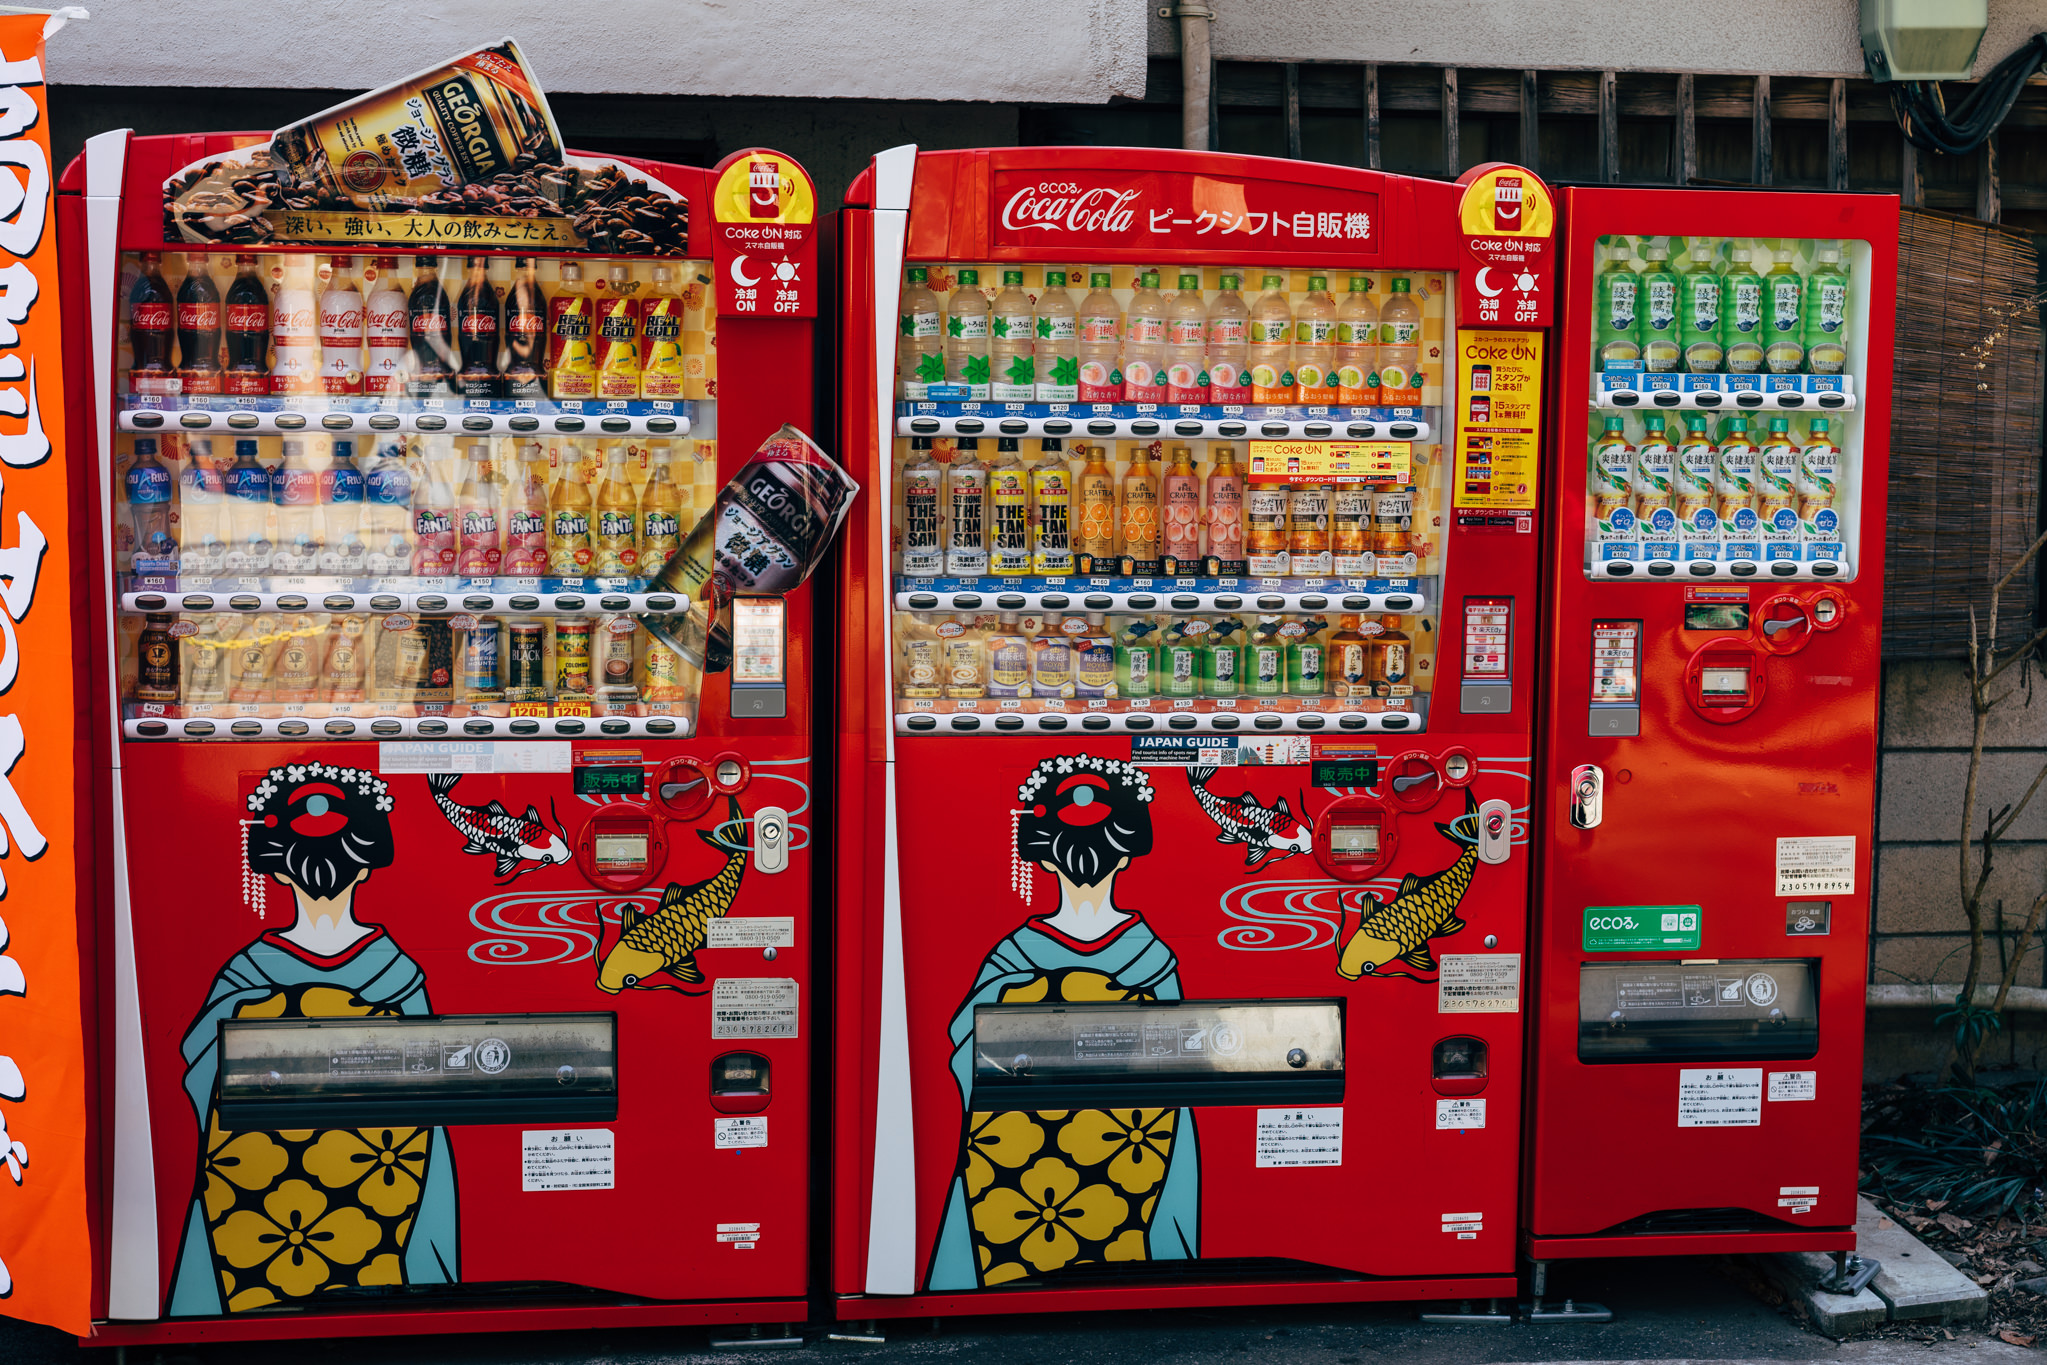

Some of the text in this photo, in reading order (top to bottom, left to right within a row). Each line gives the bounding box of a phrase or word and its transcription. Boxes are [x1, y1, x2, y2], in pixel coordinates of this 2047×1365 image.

[433, 90, 452, 121] QUALITY
[443, 83, 495, 173] GEORGIA
[392, 126, 432, 178] 微糖
[1002, 188, 1143, 232] Coca-Cola
[286, 216, 569, 241] 深い、強い、大人の飲みごたえ。
[1149, 208, 1371, 239] ピークシフト自販機
[726, 226, 802, 240] Coke ON 対応
[745, 242, 785, 250] スマホ自販機
[1471, 238, 1541, 252] Coke ON 対応
[1488, 254, 1525, 262] スマホ自販機
[735, 289, 756, 300] 冷却
[776, 290, 797, 301] 冷却
[1613, 288, 1627, 313] 綾鷹
[736, 301, 756, 311] ON
[774, 302, 799, 312] OFF
[1479, 299, 1499, 309] 冷却
[1517, 300, 1536, 311] 冷却
[132, 309, 170, 327] Coca-Cola
[228, 310, 265, 328] Coca-Cola
[366, 309, 408, 329] Coca-Cola
[461, 313, 496, 331] Coca-Cola
[1480, 311, 1498, 321] ON
[1515, 312, 1538, 322] OFF
[555, 324, 591, 337] GOLD
[1093, 325, 1113, 336] 白桃
[1268, 327, 1280, 341] 梨
[1466, 344, 1536, 360] Coke ON
[1496, 374, 1530, 382] スタンプが
[1495, 402, 1530, 410] 15スタンプで
[1274, 444, 1322, 454] Coke ON
[1601, 454, 1633, 465] 爽健美茶
[1808, 455, 1838, 466] 爽健美茶
[750, 478, 815, 540] GEORGIA
[906, 504, 937, 518] THE
[1039, 504, 1067, 519] THE
[1378, 500, 1400, 509] からだ
[1401, 500, 1412, 514] W
[462, 517, 497, 534] FANTA
[555, 518, 589, 535] FANTA
[907, 518, 937, 533] TAN
[1040, 519, 1068, 534] TAN
[1615, 518, 1631, 526] ゼロ
[908, 532, 937, 548] SAN
[1041, 533, 1068, 549] SAN
[512, 650, 540, 661] BLACK
[651, 654, 674, 662] 食べる
[1084, 654, 1111, 662] 紅茶花伝
[513, 708, 545, 717] 120円
[557, 708, 588, 717] 120円
[438, 743, 483, 753] GUIDE
[1140, 737, 1228, 747] JAPAN GUIDE
[583, 773, 638, 789] 販売中
[1319, 767, 1370, 781] 販売中
